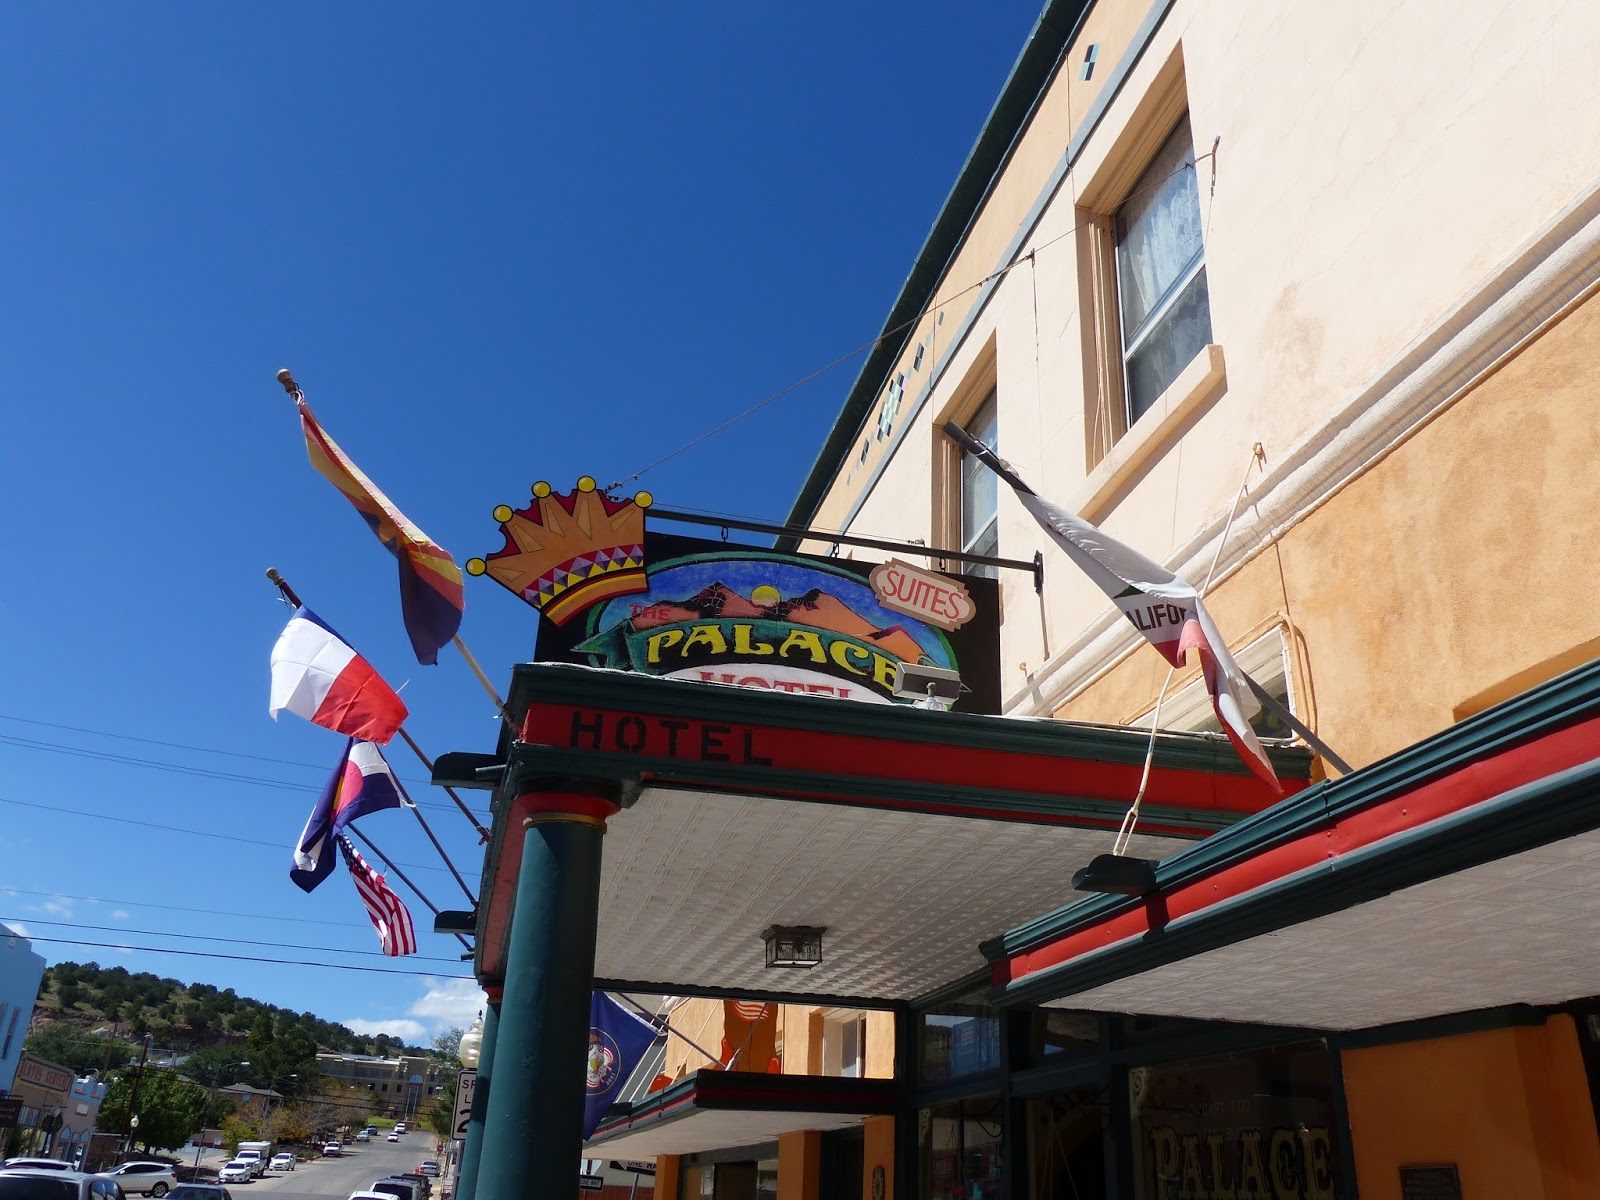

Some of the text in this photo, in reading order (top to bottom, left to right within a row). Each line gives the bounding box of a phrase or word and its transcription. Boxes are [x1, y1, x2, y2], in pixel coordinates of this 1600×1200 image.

[630, 605, 670, 620] THE
[882, 570, 963, 619] SUITES
[648, 624, 897, 691] PALACE
[571, 711, 773, 768] HOTEL
[1151, 1126, 1335, 1200] PALACE
